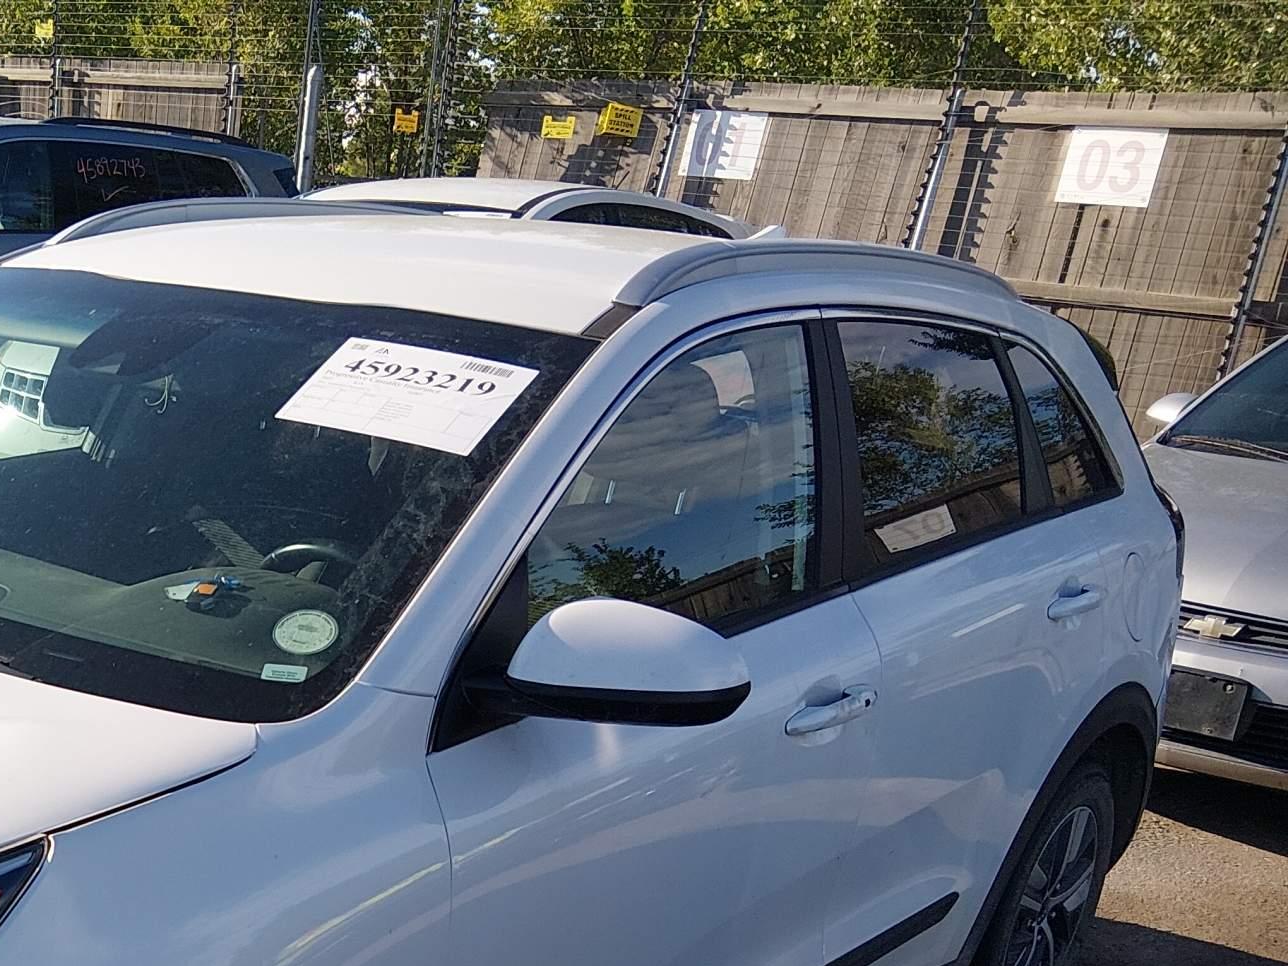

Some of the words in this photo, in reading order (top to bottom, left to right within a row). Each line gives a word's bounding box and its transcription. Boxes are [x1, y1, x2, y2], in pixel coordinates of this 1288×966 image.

[695, 120, 746, 167] 01
[77, 156, 146, 184] 45892743
[1077, 139, 1145, 193] 03
[344, 357, 497, 396] 45923219
